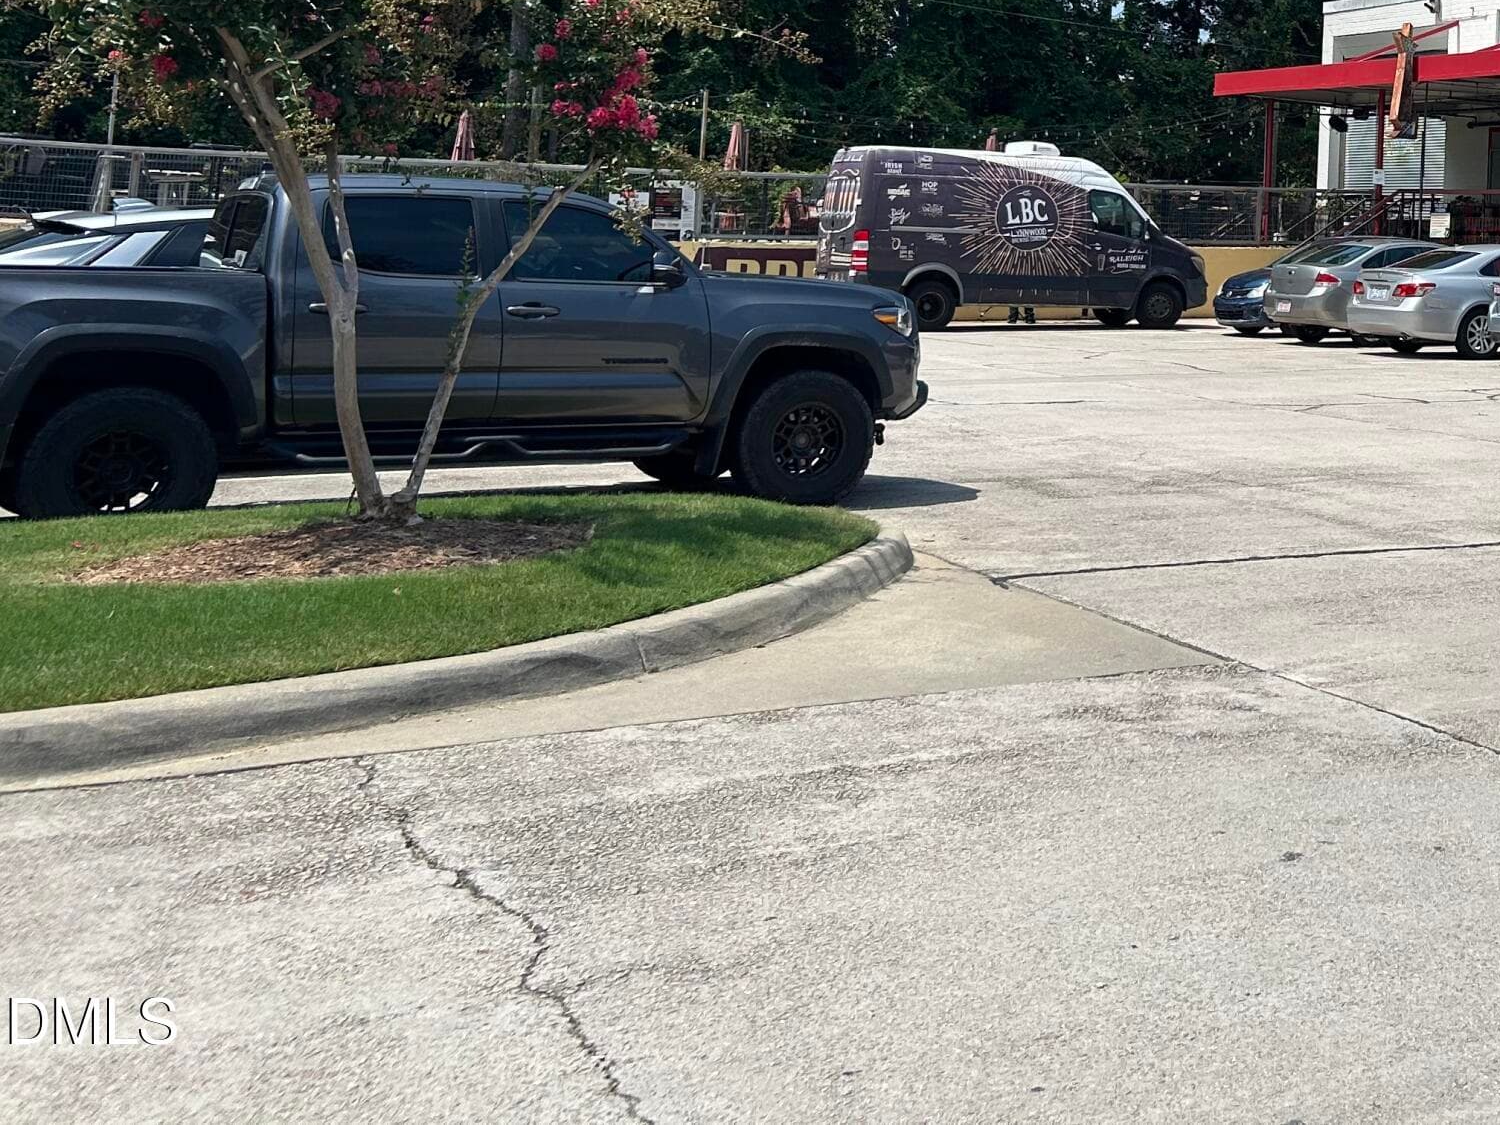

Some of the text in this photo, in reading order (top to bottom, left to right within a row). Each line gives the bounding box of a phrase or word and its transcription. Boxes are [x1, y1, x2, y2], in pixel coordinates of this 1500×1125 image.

[1005, 197, 1048, 224] LBC
[1010, 227, 1047, 238] LYNNWOOD
[1109, 255, 1144, 263] RALEIGH
